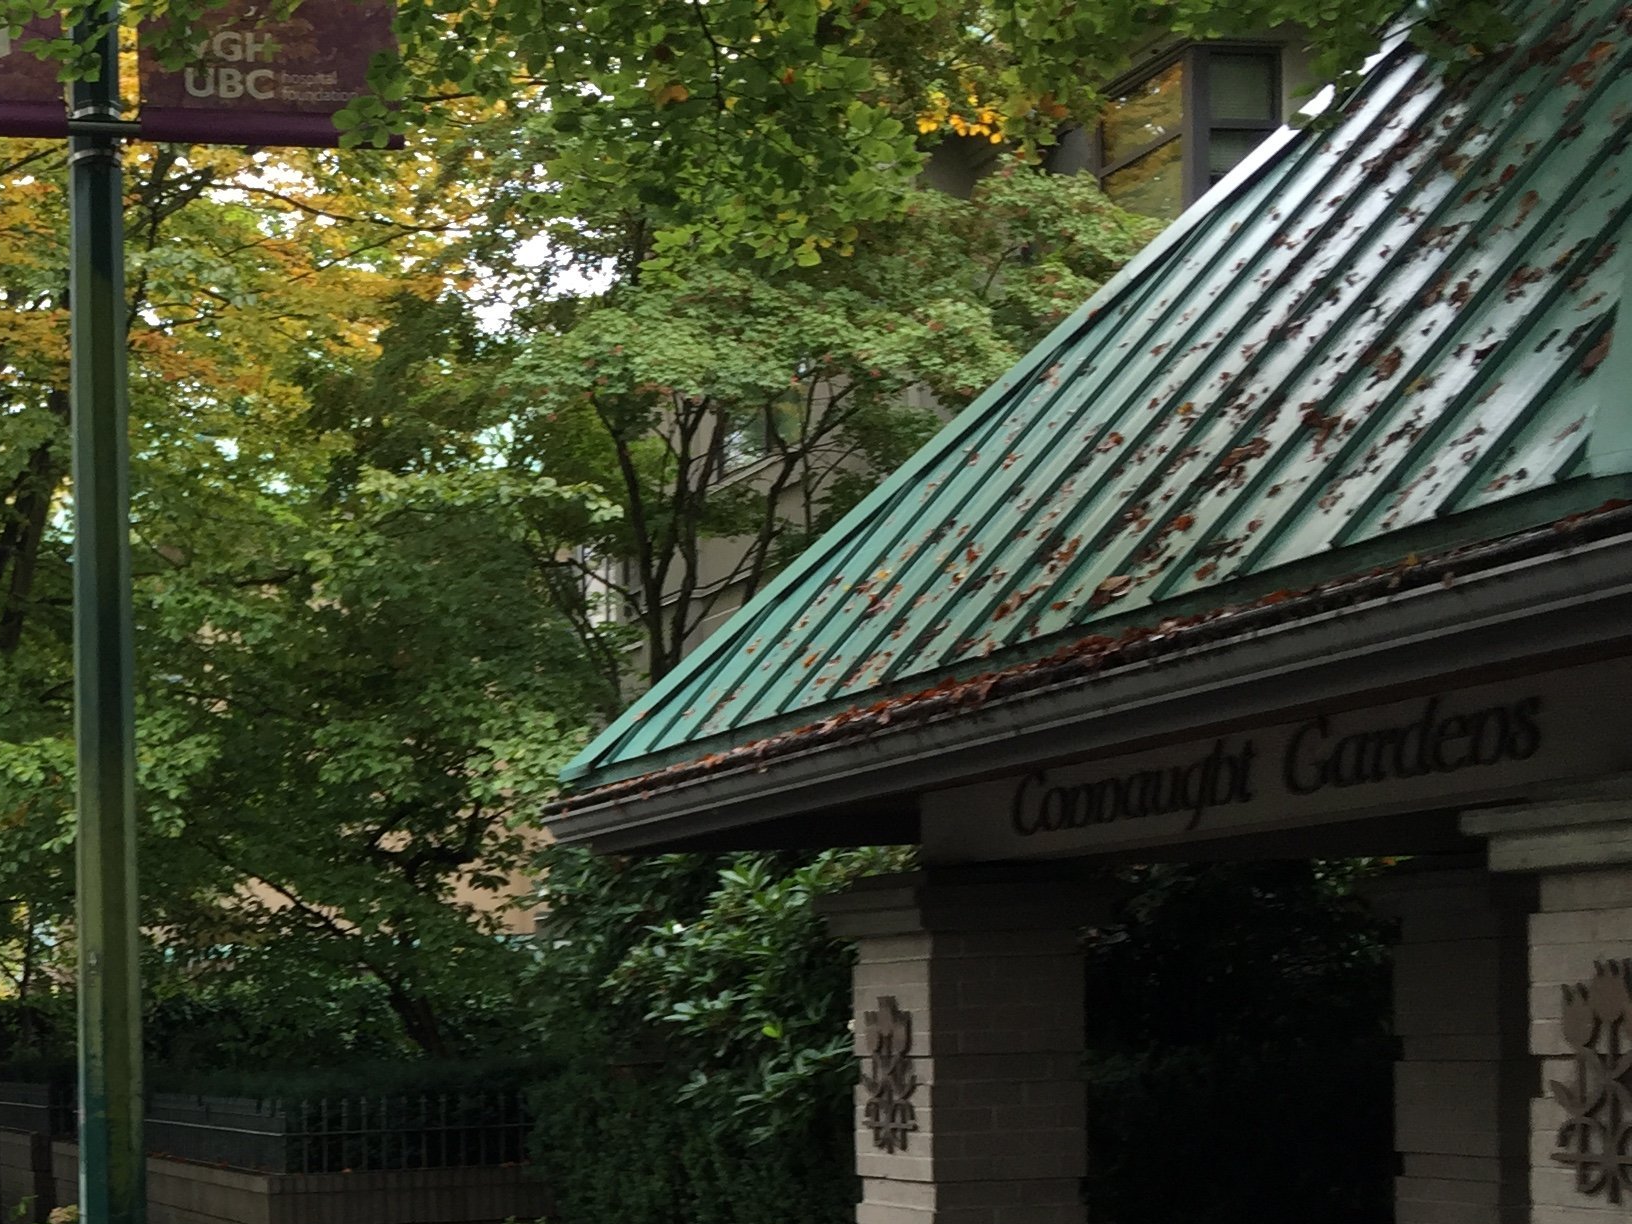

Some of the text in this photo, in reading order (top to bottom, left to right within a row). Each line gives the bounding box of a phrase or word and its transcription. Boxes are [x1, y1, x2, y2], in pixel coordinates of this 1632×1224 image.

[184, 67, 275, 99] UBC
[280, 70, 337, 85] hospital
[280, 86, 358, 102] foundation
[1011, 694, 1543, 835] Connaught Gardens
